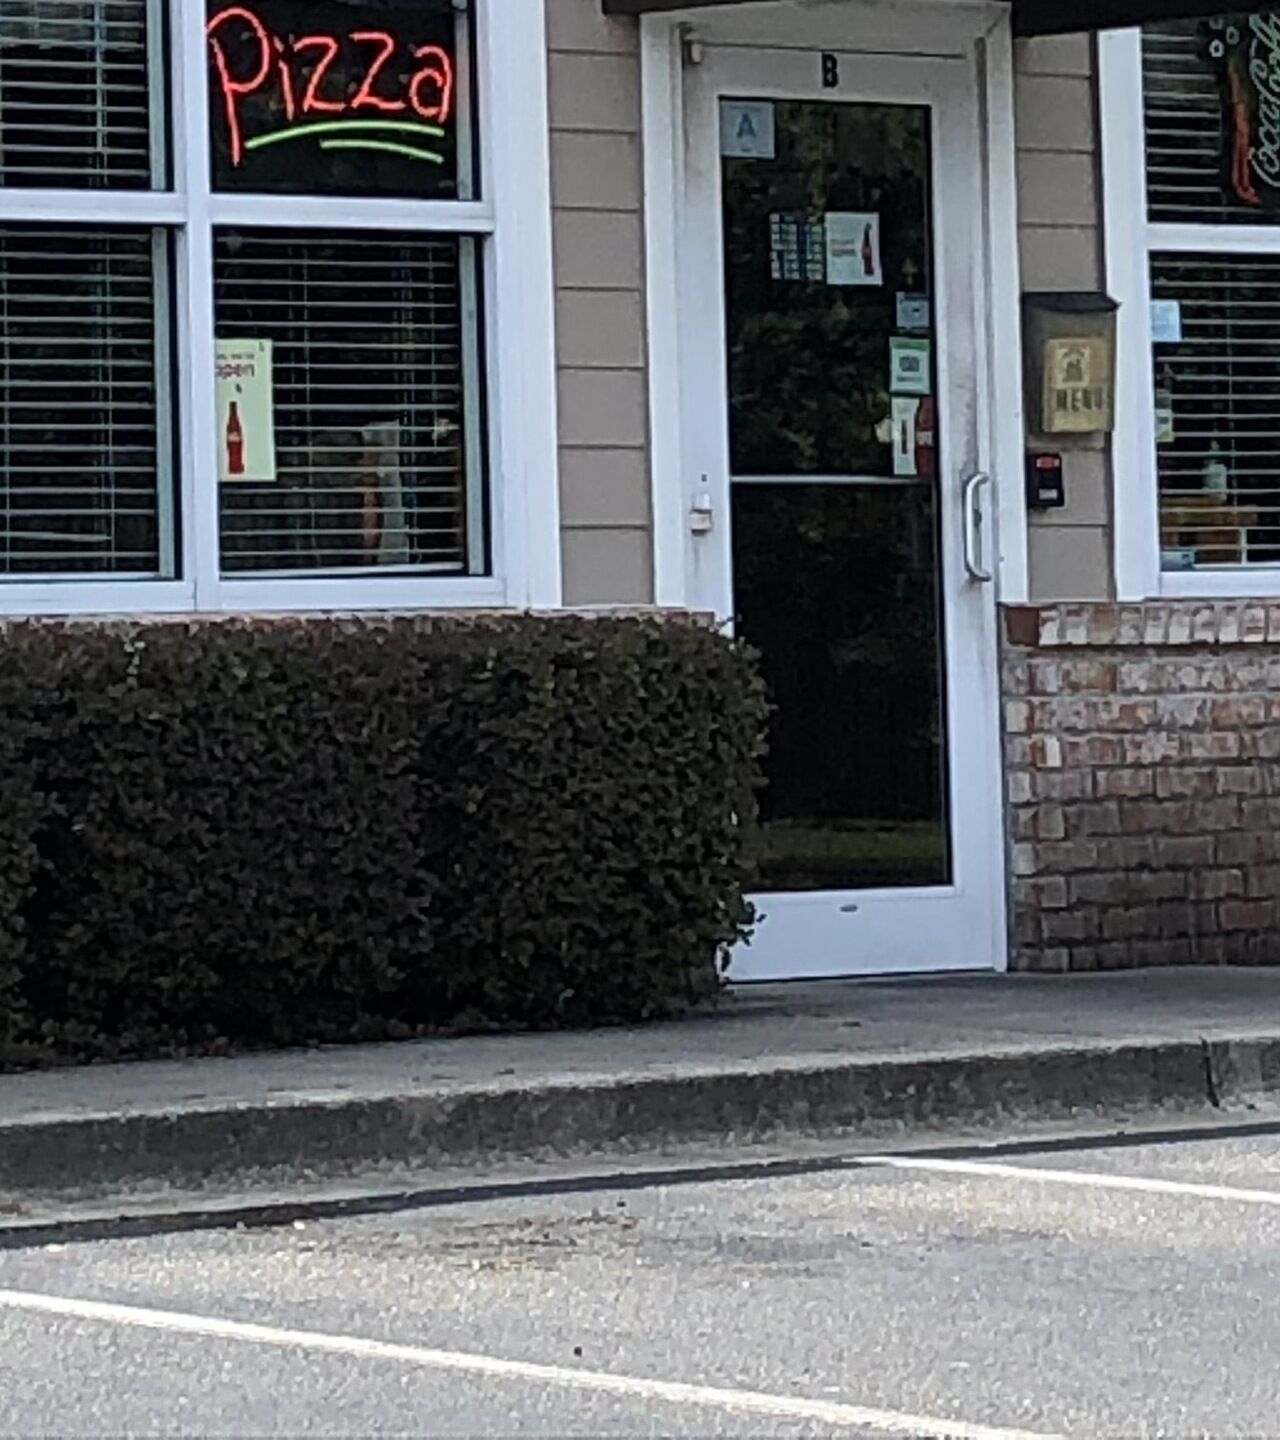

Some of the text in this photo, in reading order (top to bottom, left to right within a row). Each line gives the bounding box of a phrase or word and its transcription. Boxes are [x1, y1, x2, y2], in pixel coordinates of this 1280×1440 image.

[206, 7, 453, 167] Pizza
[821, 53, 839, 88] B
[736, 112, 757, 139] A
